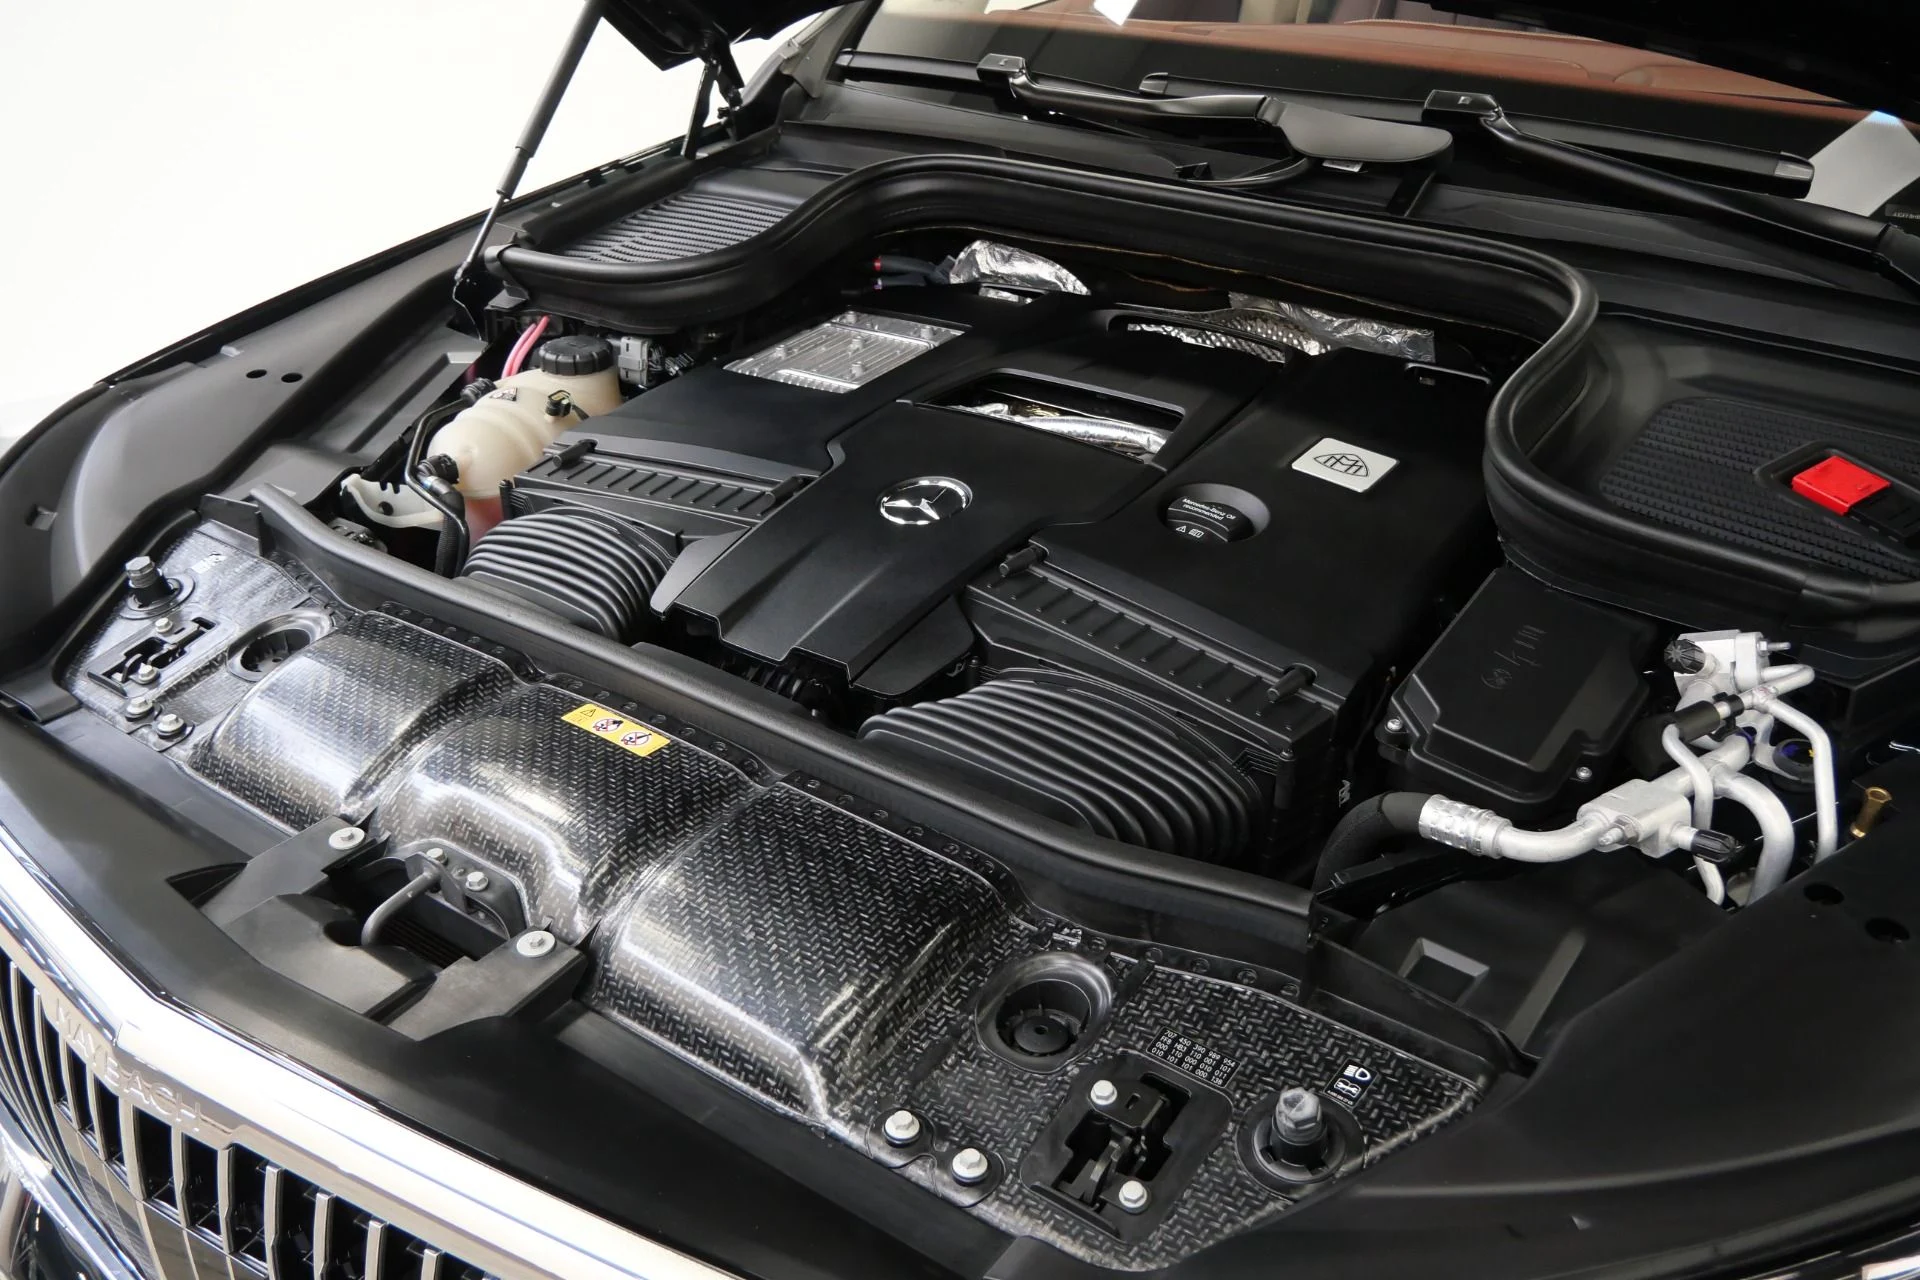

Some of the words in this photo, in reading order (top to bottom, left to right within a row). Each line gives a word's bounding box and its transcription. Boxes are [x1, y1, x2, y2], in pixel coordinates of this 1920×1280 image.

[56, 998, 200, 1132] MAYBACH
[1151, 1047, 1164, 1057] 010
[1166, 1055, 1178, 1064] 101
[1181, 1062, 1193, 1071] 101
[1194, 1068, 1208, 1078] 000
[1155, 1041, 1169, 1051] 000
[1171, 1049, 1183, 1058] 110
[1184, 1056, 1198, 1065] 000
[1199, 1063, 1213, 1072] 010
[1214, 1070, 1227, 1079] 011
[1164, 1030, 1178, 1039] 707
[1179, 1037, 1192, 1047] 450
[1192, 1043, 1206, 1054] 390
[1208, 1051, 1221, 1060] 989
[1223, 1058, 1236, 1068] 954
[1190, 1050, 1202, 1060] 110
[1203, 1057, 1217, 1066] 001
[1219, 1064, 1232, 1073] 101
